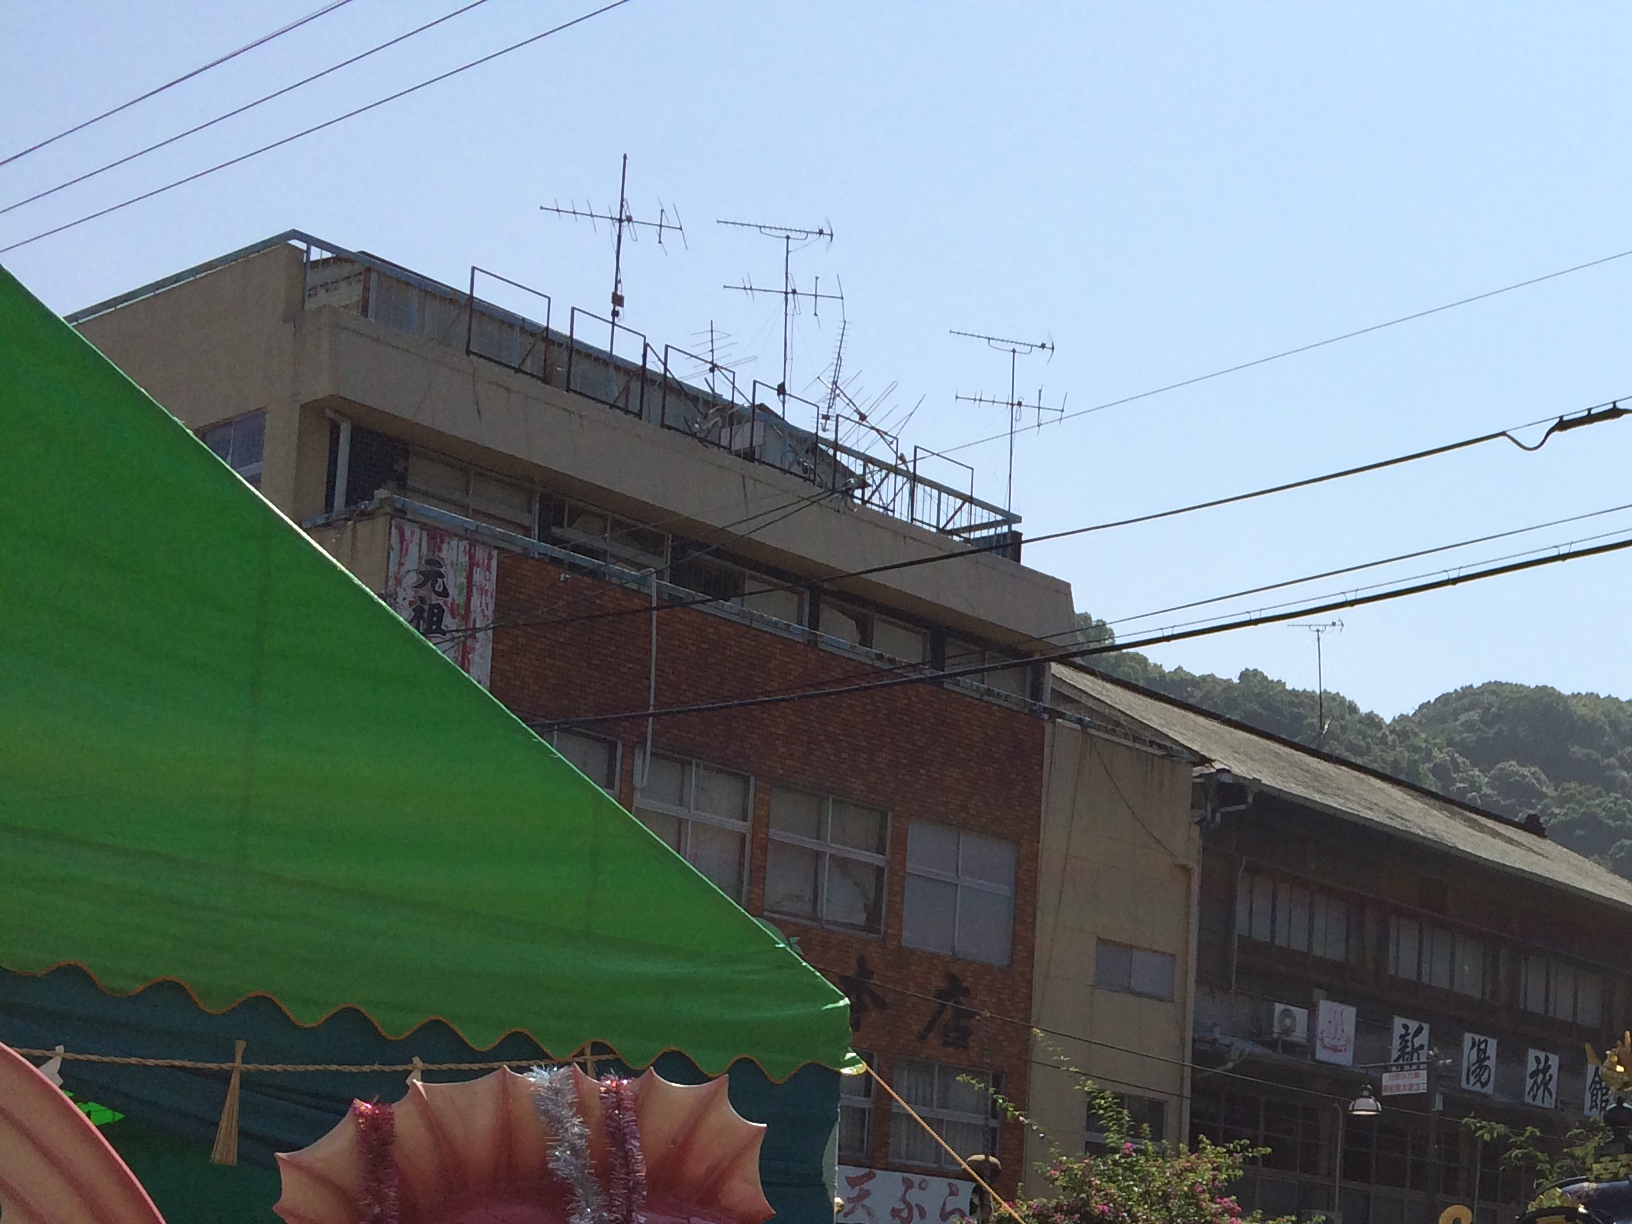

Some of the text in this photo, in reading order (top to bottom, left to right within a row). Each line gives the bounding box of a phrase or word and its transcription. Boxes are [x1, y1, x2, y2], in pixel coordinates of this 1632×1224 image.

[411, 557, 450, 636] 元祖
[838, 955, 982, 1049] 本店
[1396, 1022, 1611, 1112] 新湯旅館
